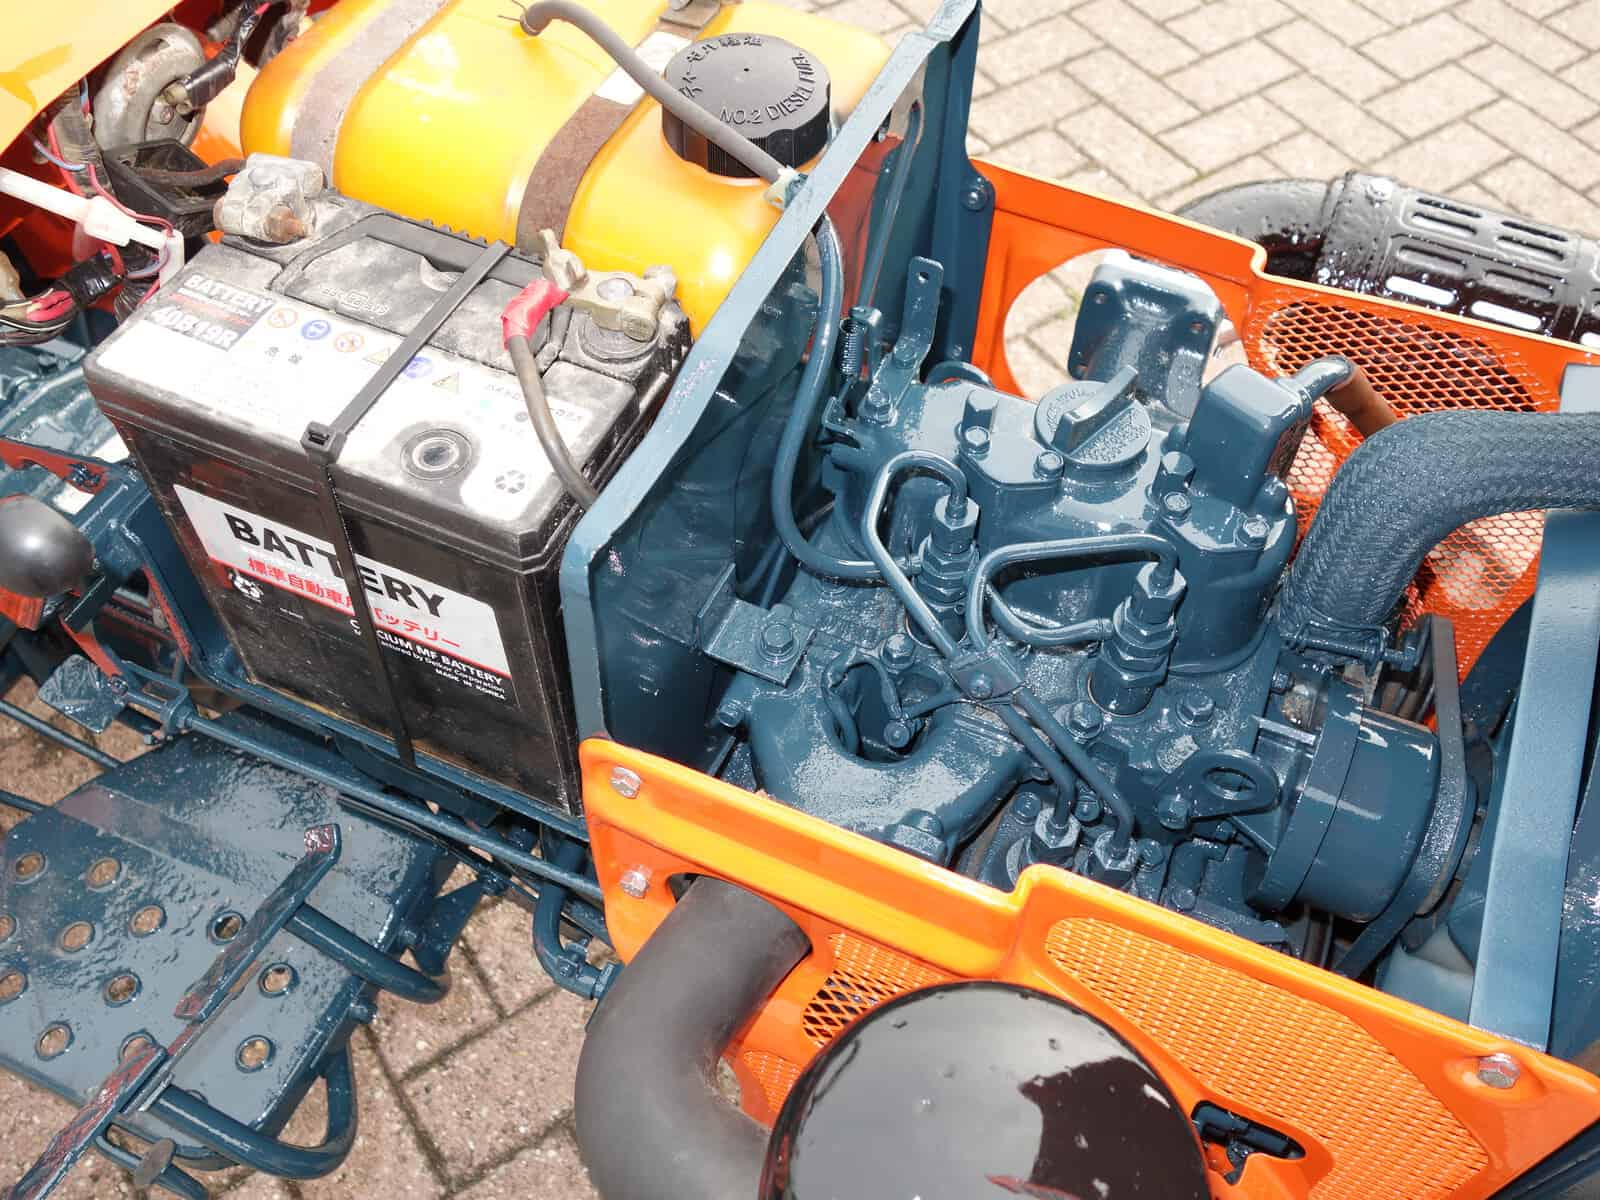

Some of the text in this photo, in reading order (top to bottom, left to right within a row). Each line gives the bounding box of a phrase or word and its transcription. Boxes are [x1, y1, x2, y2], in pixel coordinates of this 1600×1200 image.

[720, 52, 816, 125] NO.2 DIESEL FUEL
[184, 274, 273, 313] BATTERY
[151, 303, 239, 349] 40B19R
[224, 513, 445, 618] BATTERY
[416, 644, 438, 660] MF
[441, 656, 503, 685] BATTERY
[453, 667, 505, 693] Corporation
[475, 683, 506, 700] KOREA
